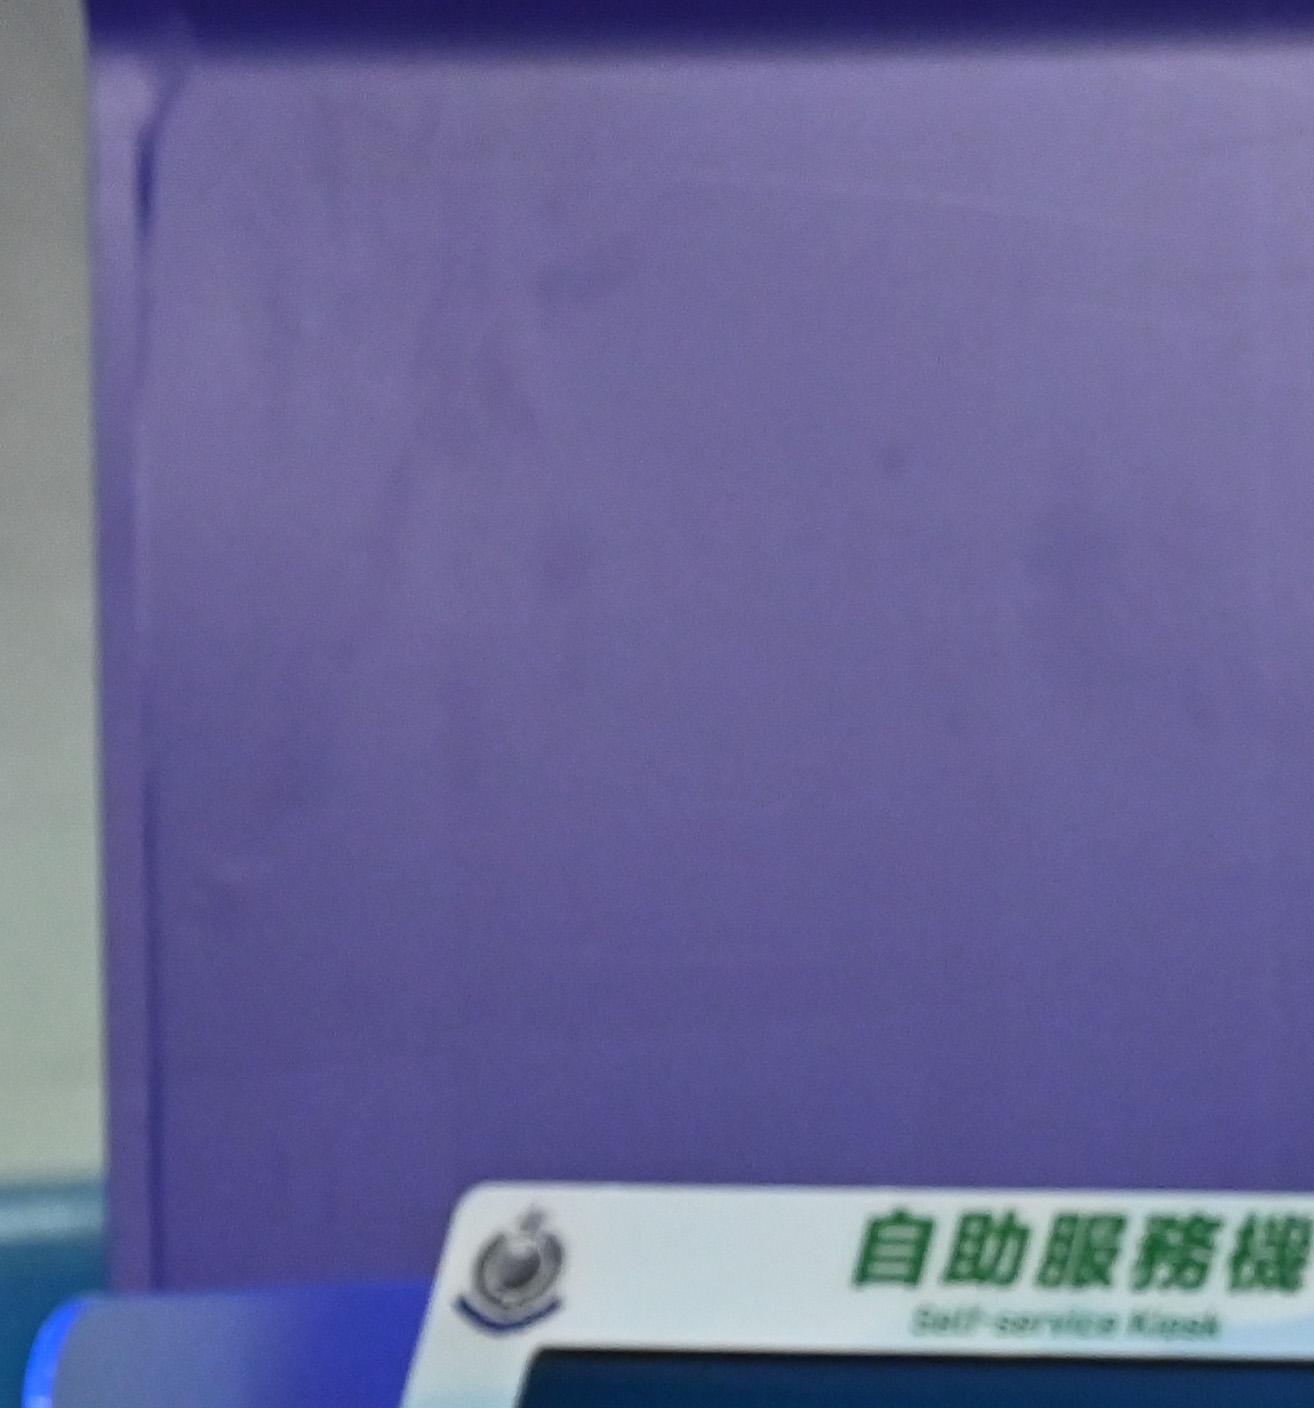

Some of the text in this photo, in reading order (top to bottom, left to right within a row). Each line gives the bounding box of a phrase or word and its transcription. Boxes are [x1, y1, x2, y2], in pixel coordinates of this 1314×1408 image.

[853, 1208, 1314, 1296] 自助服務機
[912, 1304, 1221, 1341] Self-service Kiosk
